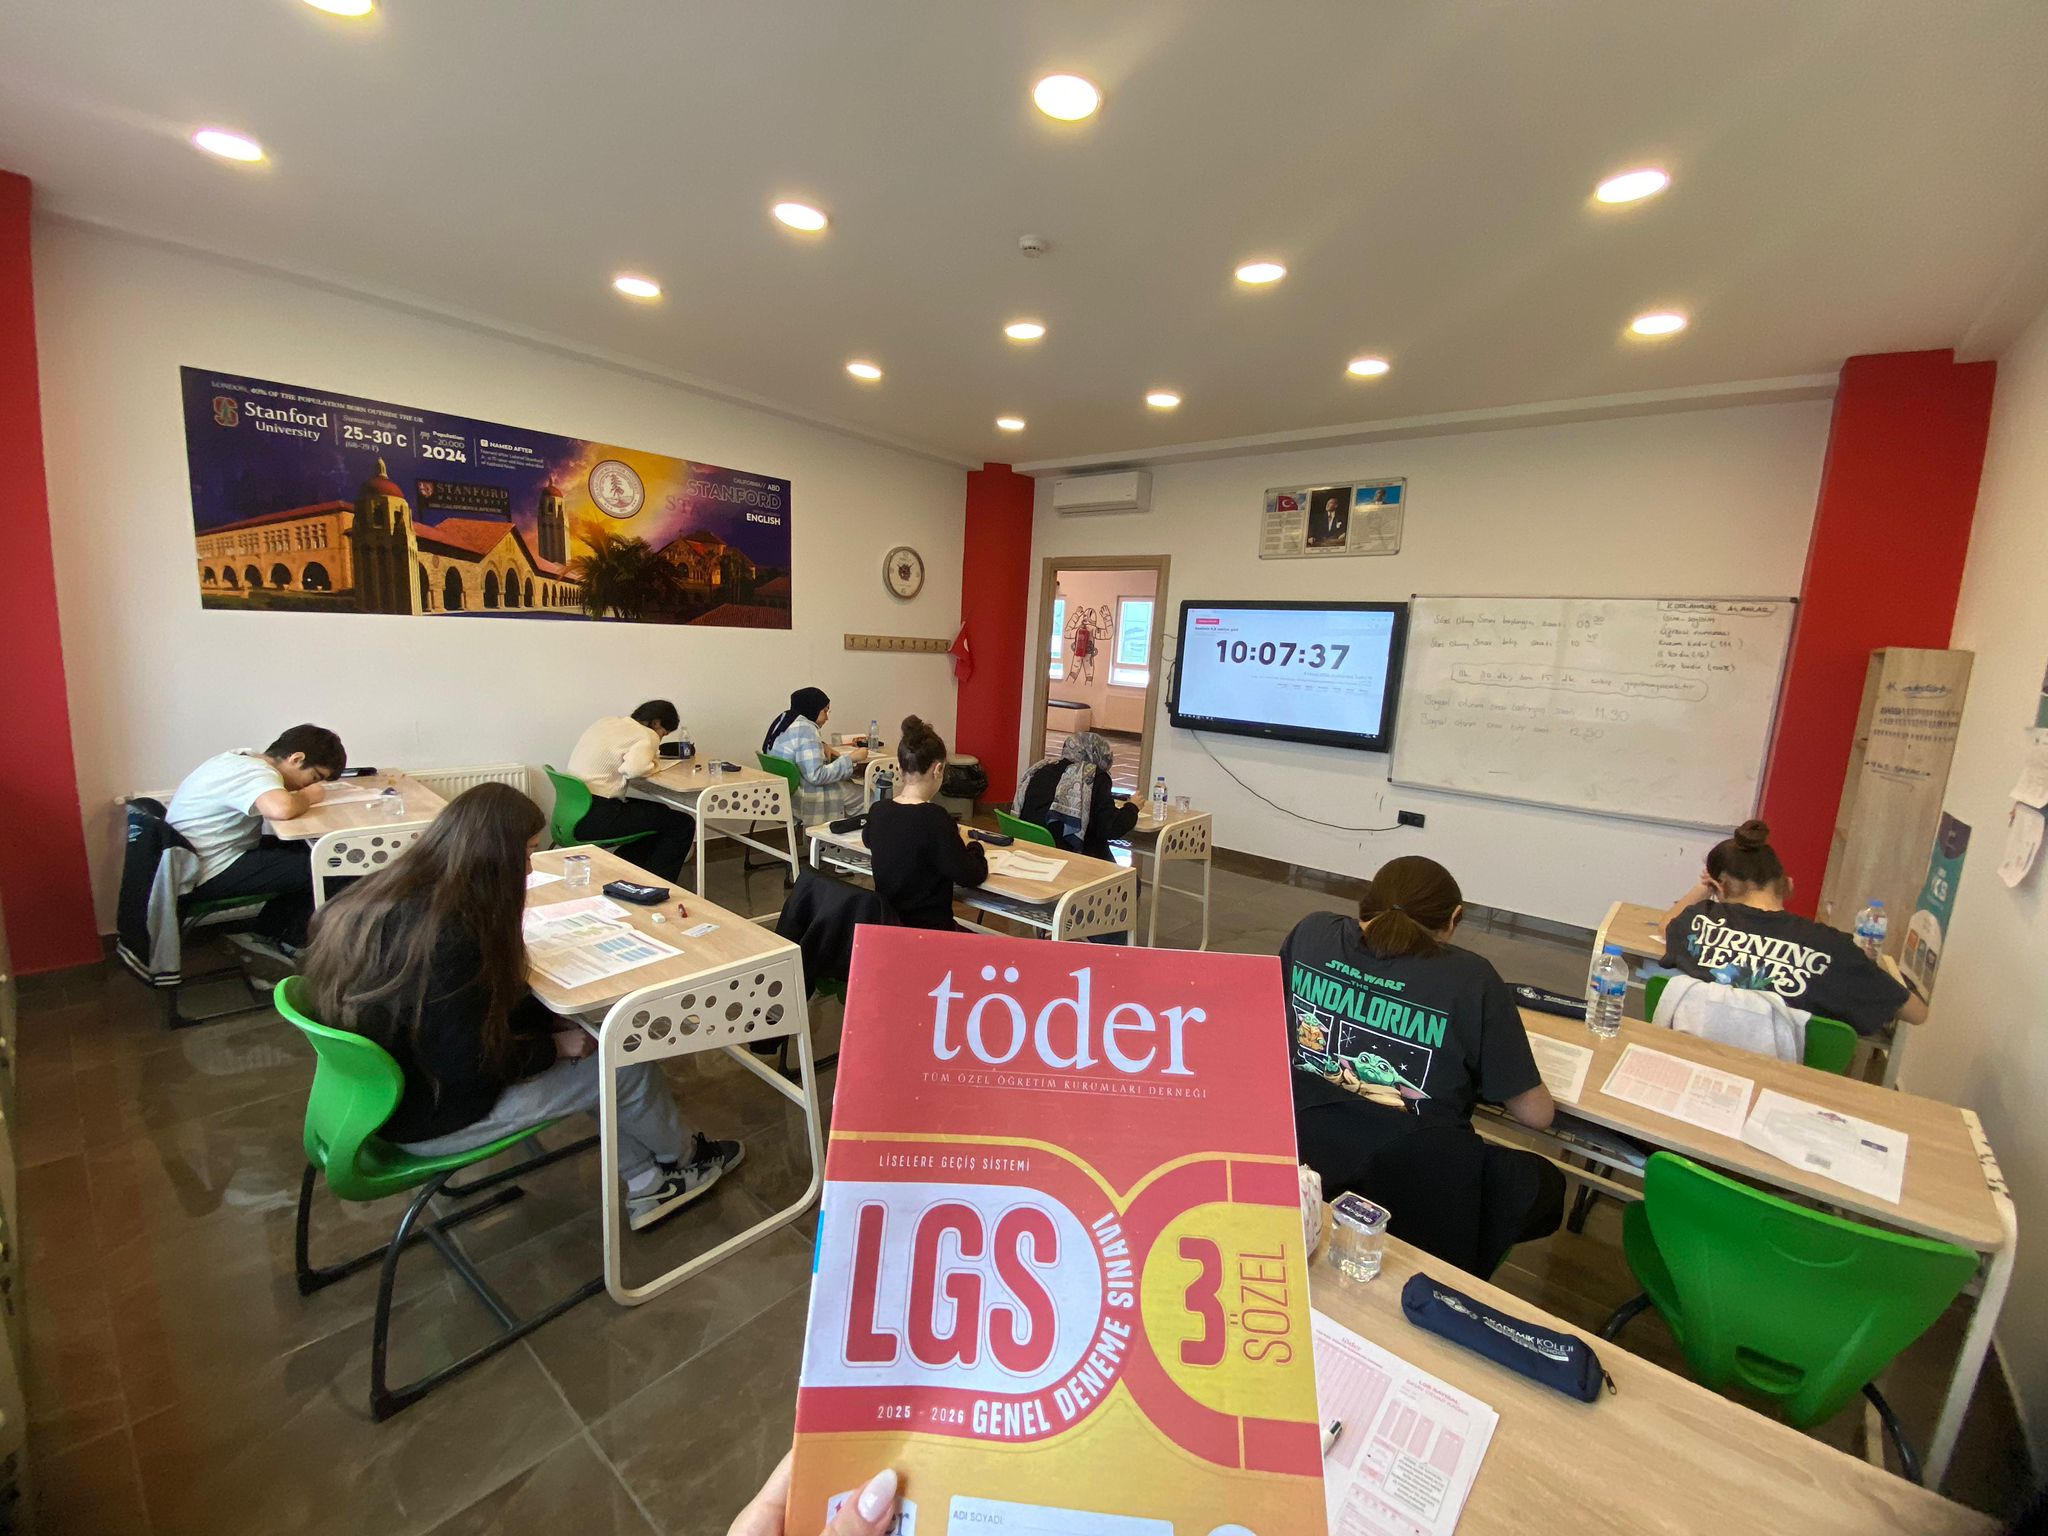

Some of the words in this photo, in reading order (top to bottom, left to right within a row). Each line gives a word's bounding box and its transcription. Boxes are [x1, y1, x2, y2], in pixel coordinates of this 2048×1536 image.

[244, 401, 329, 428] Stanford
[255, 420, 320, 442] University
[421, 444, 467, 464] 2024
[489, 441, 513, 451] NAMED
[513, 445, 533, 454] AFTER
[436, 483, 509, 500] STANFORD
[686, 479, 782, 510] STANFORD
[746, 512, 781, 526] ENGLISH
[1216, 639, 1350, 670] 10:07:37
[1690, 914, 1831, 976] TURNING
[1325, 959, 1362, 980] STAR
[1362, 972, 1406, 992] WARS
[1350, 980, 1370, 991] THE
[1697, 945, 1811, 998] LEAVES
[927, 964, 1207, 1076] töder
[1290, 965, 1448, 1049] MANDALORIAN
[921, 1071, 951, 1083] TÜM
[957, 1072, 991, 1085] ÖZEL
[997, 1074, 1057, 1089] ÖĞRETİM
[1064, 1079, 1142, 1095] KURUMLARI
[879, 1153, 934, 1168] LİSELERE
[941, 1154, 977, 1171] GEÇİŞ
[982, 1155, 1031, 1172] SİSTEMİ
[1091, 1211, 1135, 1309] SINAVI
[843, 1202, 1058, 1373] LGS
[1177, 1234, 1227, 1368] 3
[1229, 1243, 1294, 1365] SÖZEL
[1053, 1316, 1132, 1422] DENEME
[877, 1405, 912, 1419] 2025
[931, 1407, 964, 1424] 2026
[971, 1398, 1051, 1437] GENEL
[953, 1509, 968, 1520] ADI
